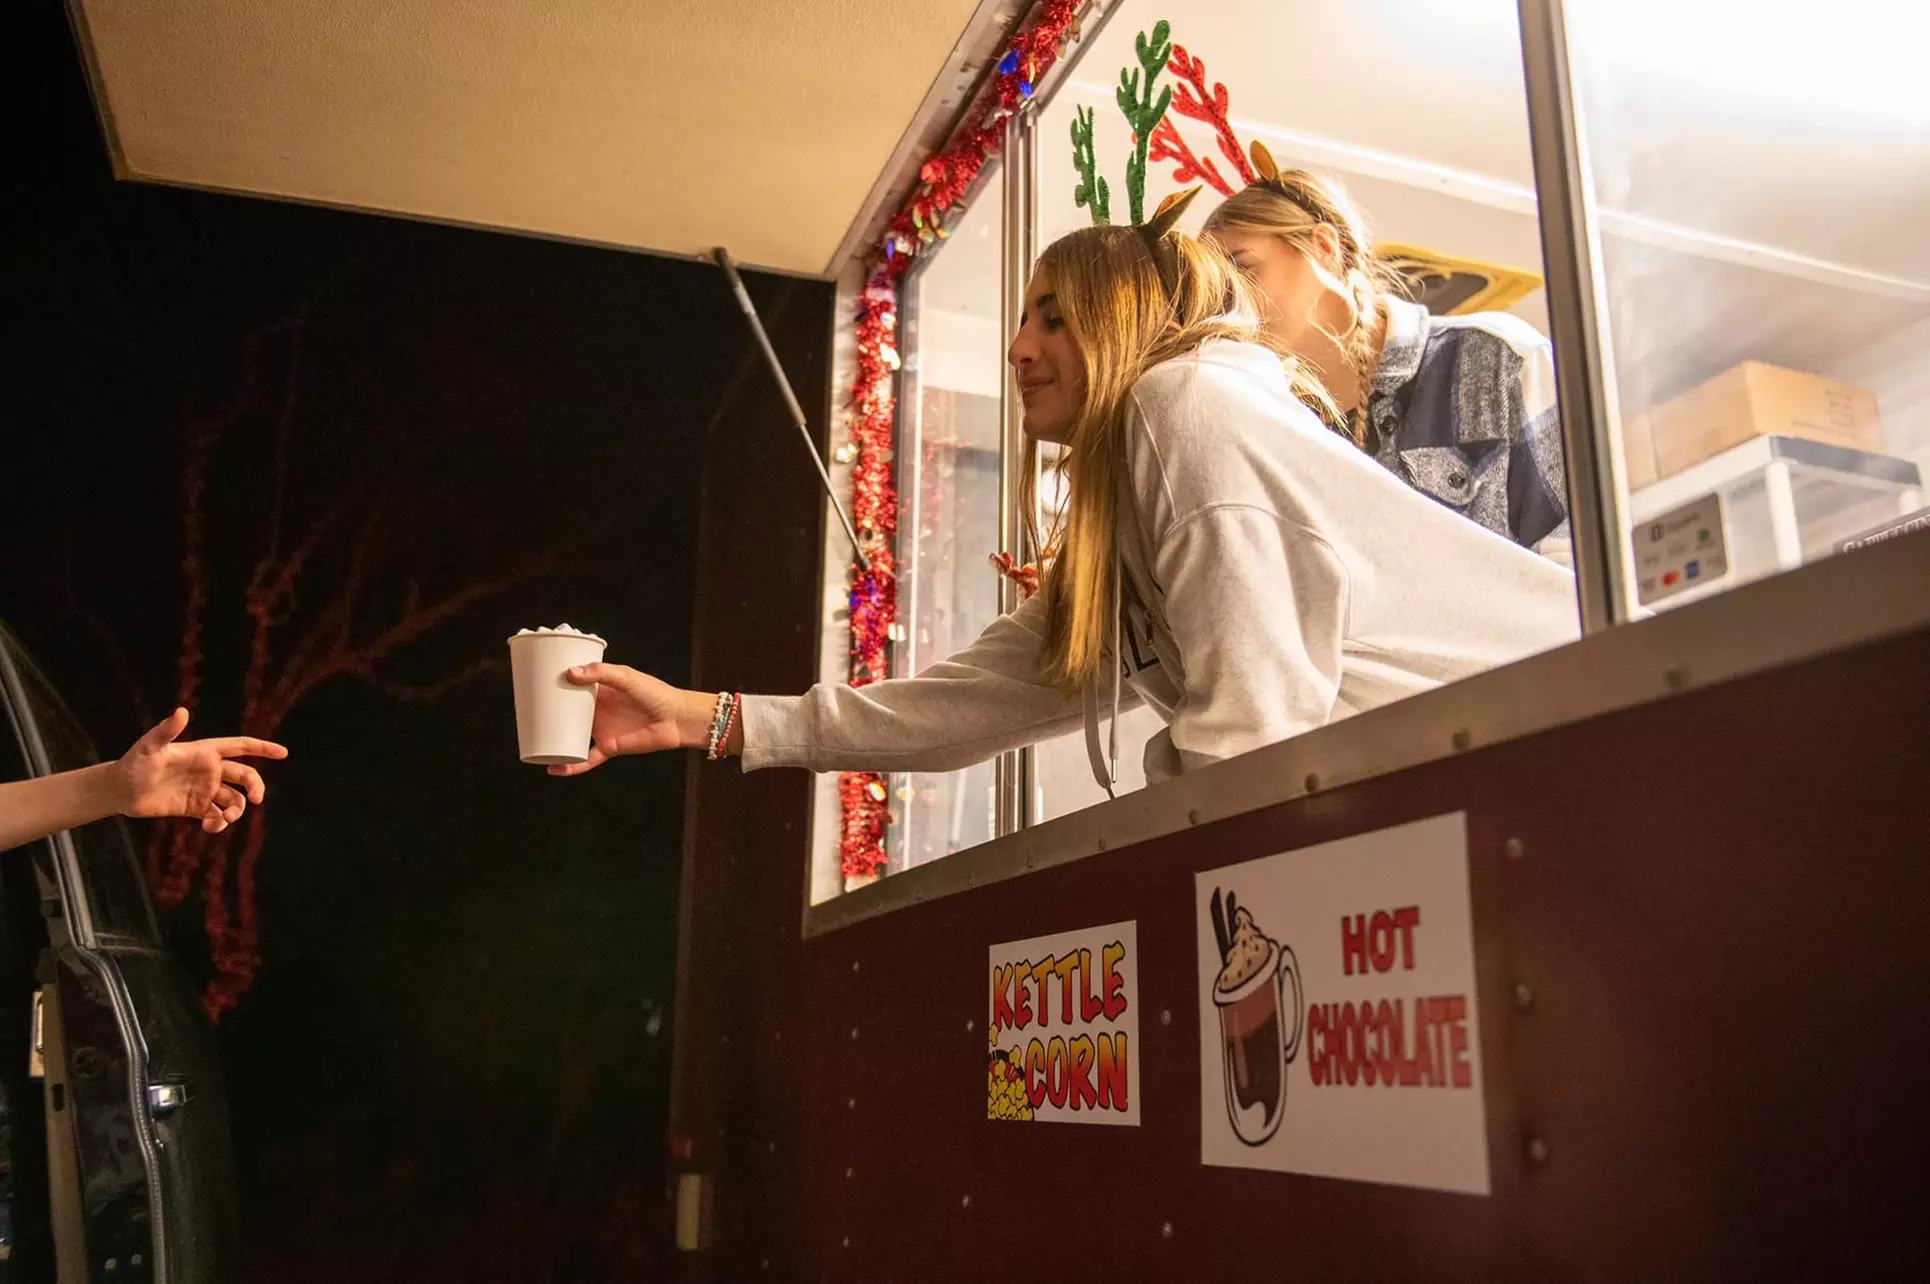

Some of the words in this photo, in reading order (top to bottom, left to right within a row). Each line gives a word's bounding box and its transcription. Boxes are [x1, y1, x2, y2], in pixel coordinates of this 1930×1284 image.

[1341, 906, 1420, 976] HOT
[993, 940, 1127, 1032] KETTLE
[1024, 1031, 1129, 1112] CORN
[1307, 994, 1472, 1089] CHOCOLATE
